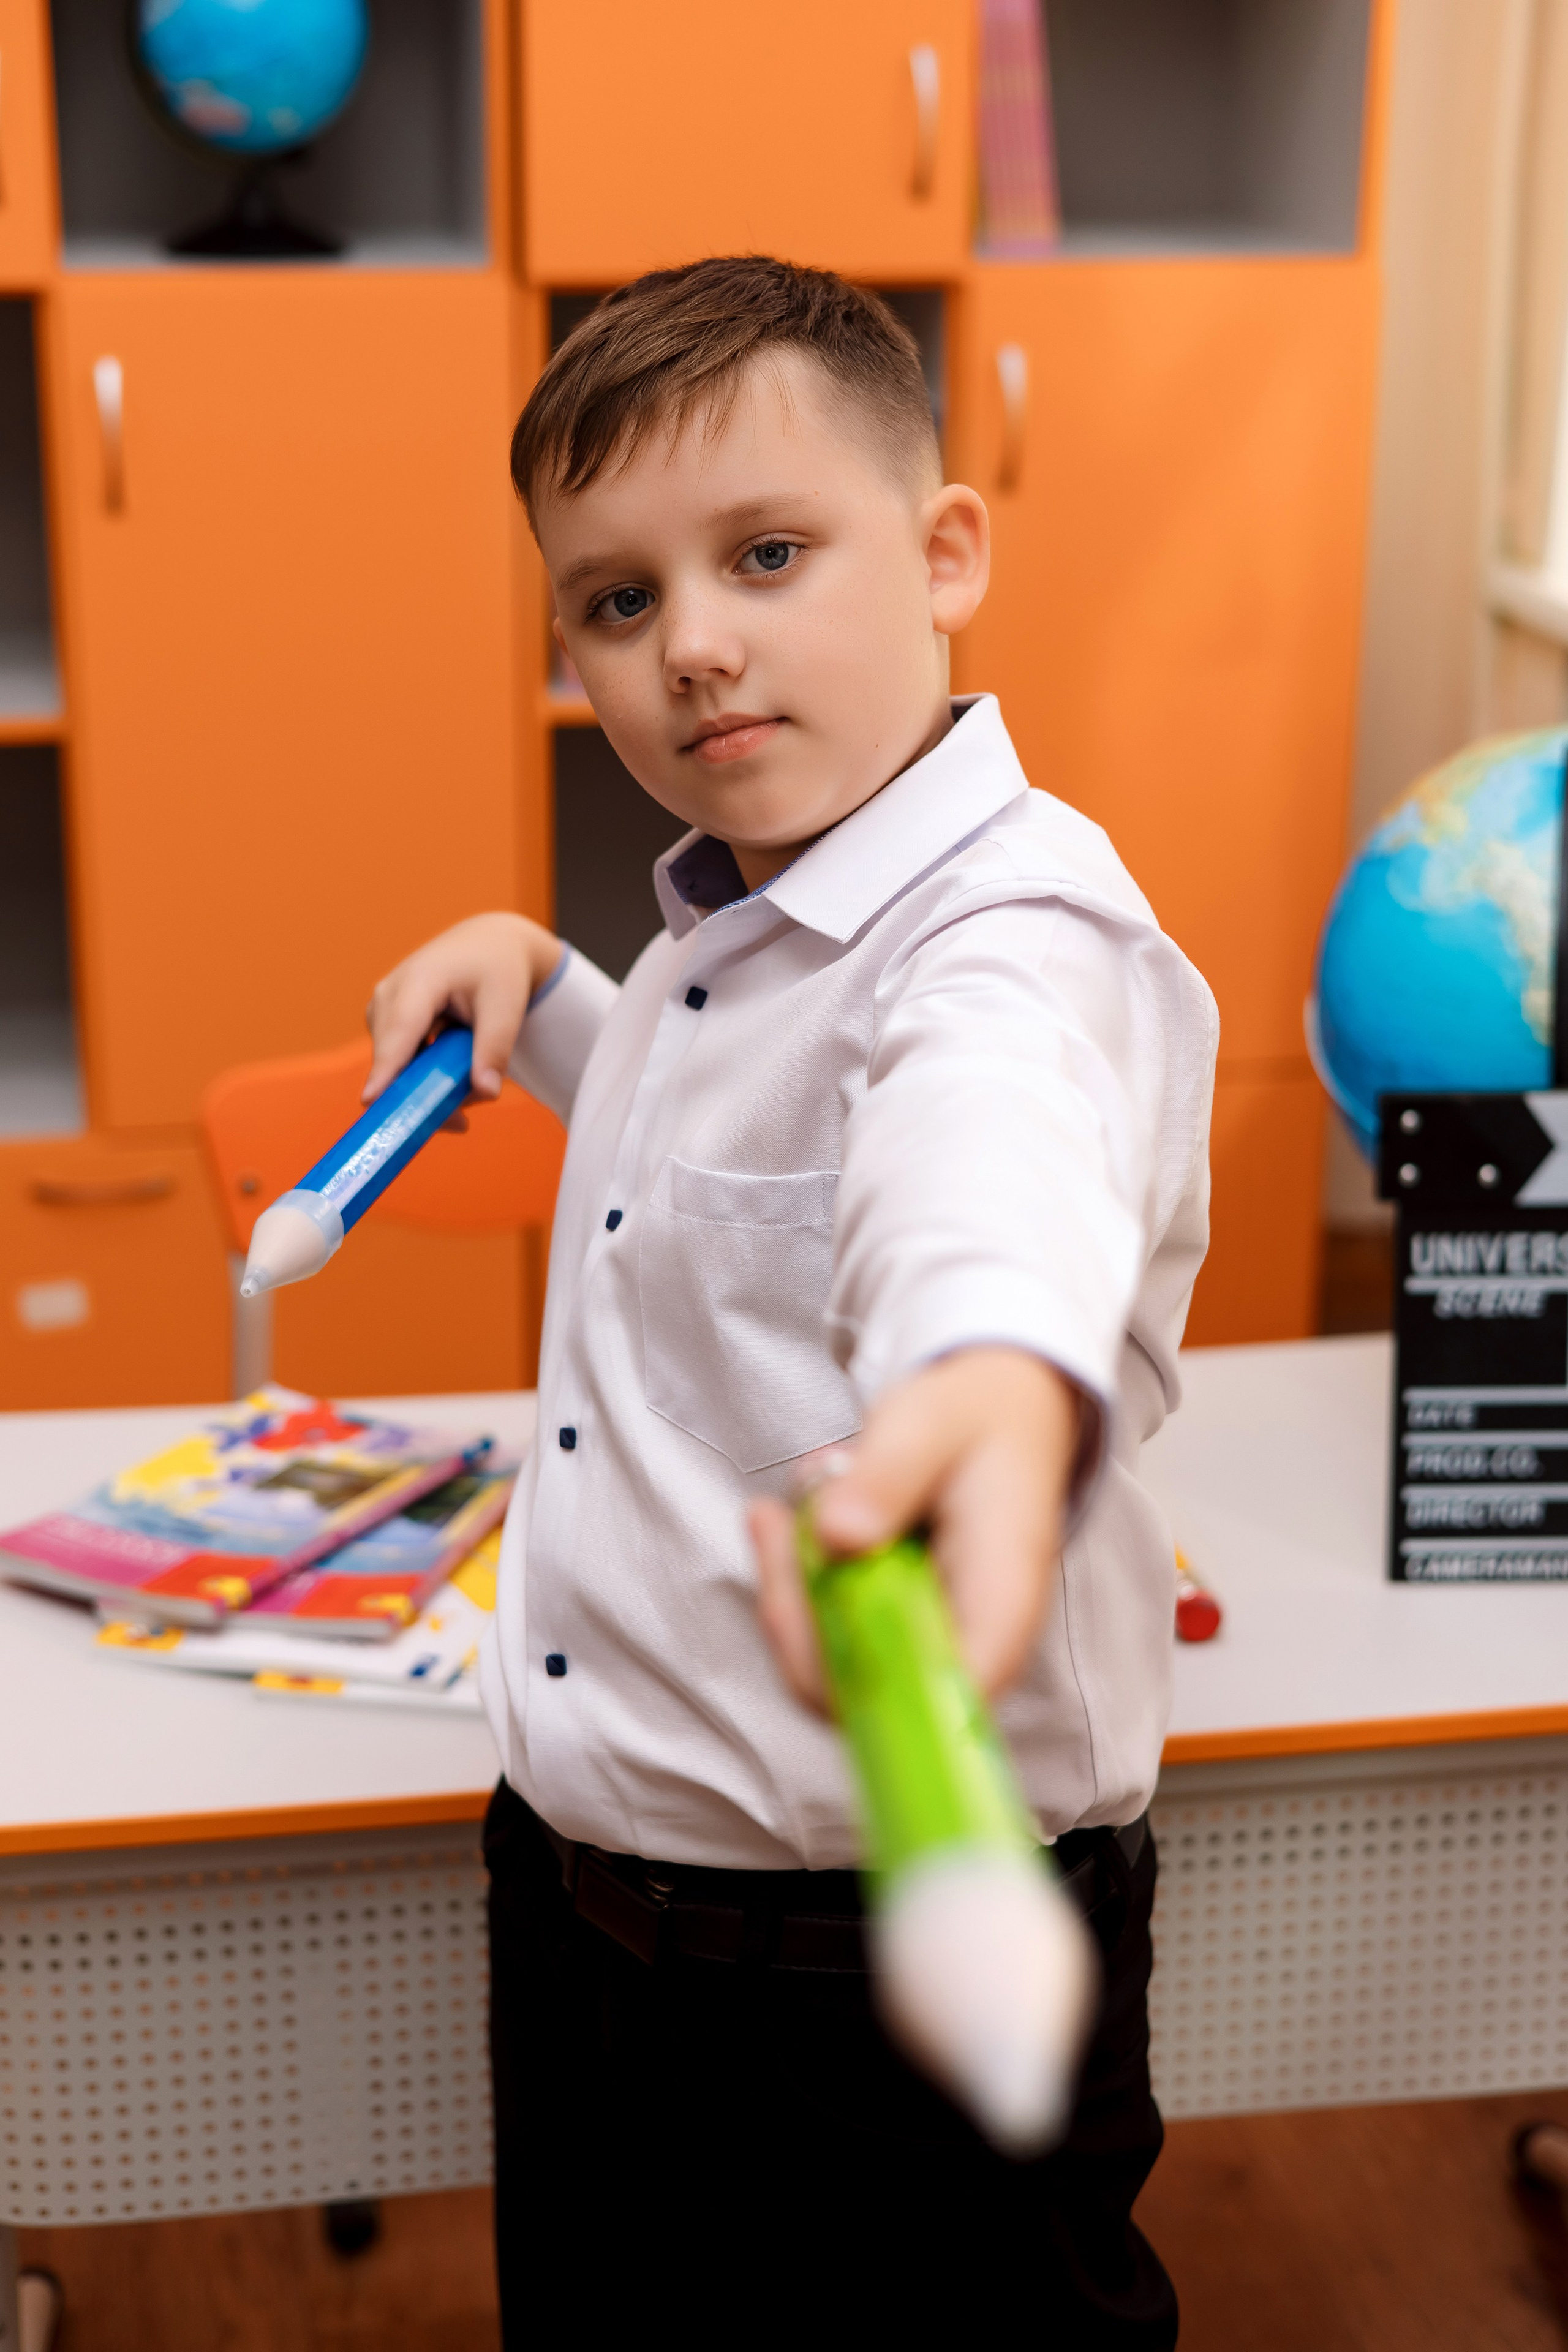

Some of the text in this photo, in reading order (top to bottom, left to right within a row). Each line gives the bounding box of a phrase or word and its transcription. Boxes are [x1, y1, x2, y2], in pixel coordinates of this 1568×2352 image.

[1434, 1287, 1544, 1317] SCENE
[1407, 1401, 1474, 1427] DATE
[1406, 1498, 1544, 1528] DIRECTOR
